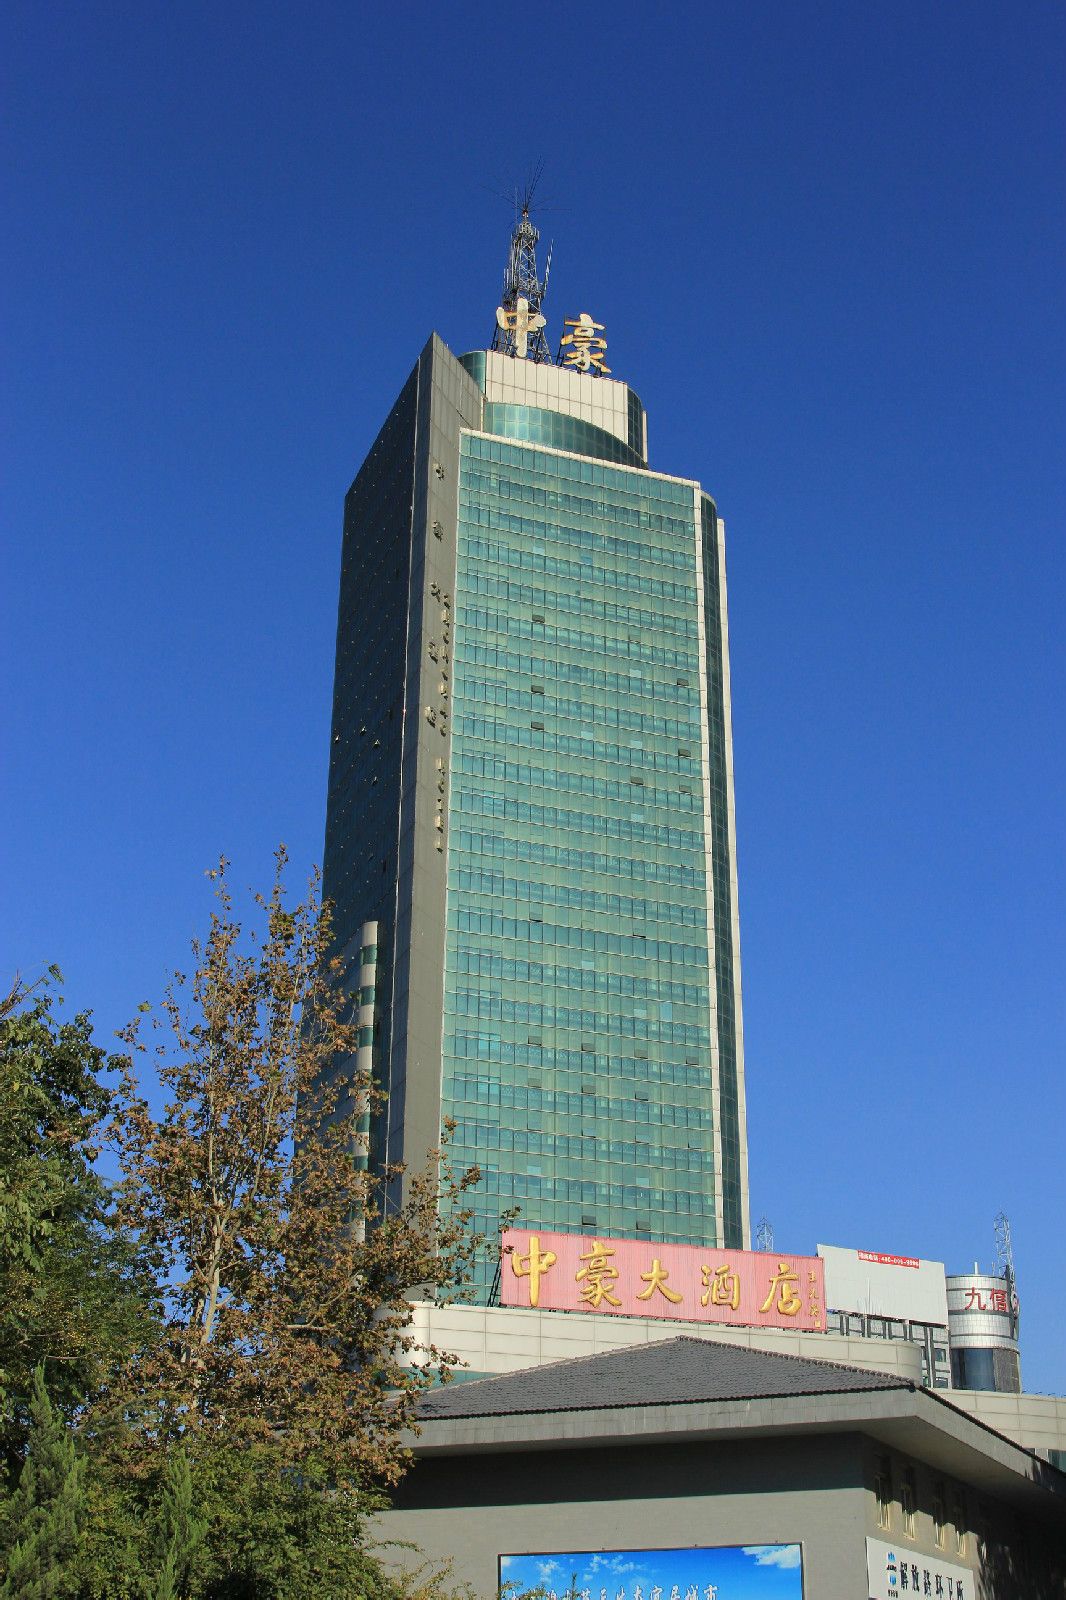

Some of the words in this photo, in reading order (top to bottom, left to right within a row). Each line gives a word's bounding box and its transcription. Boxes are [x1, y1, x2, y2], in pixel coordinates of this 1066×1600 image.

[496, 297, 612, 373] 中豪
[511, 1236, 803, 1316] 中豪大酒店
[965, 1287, 1008, 1311] 九信
